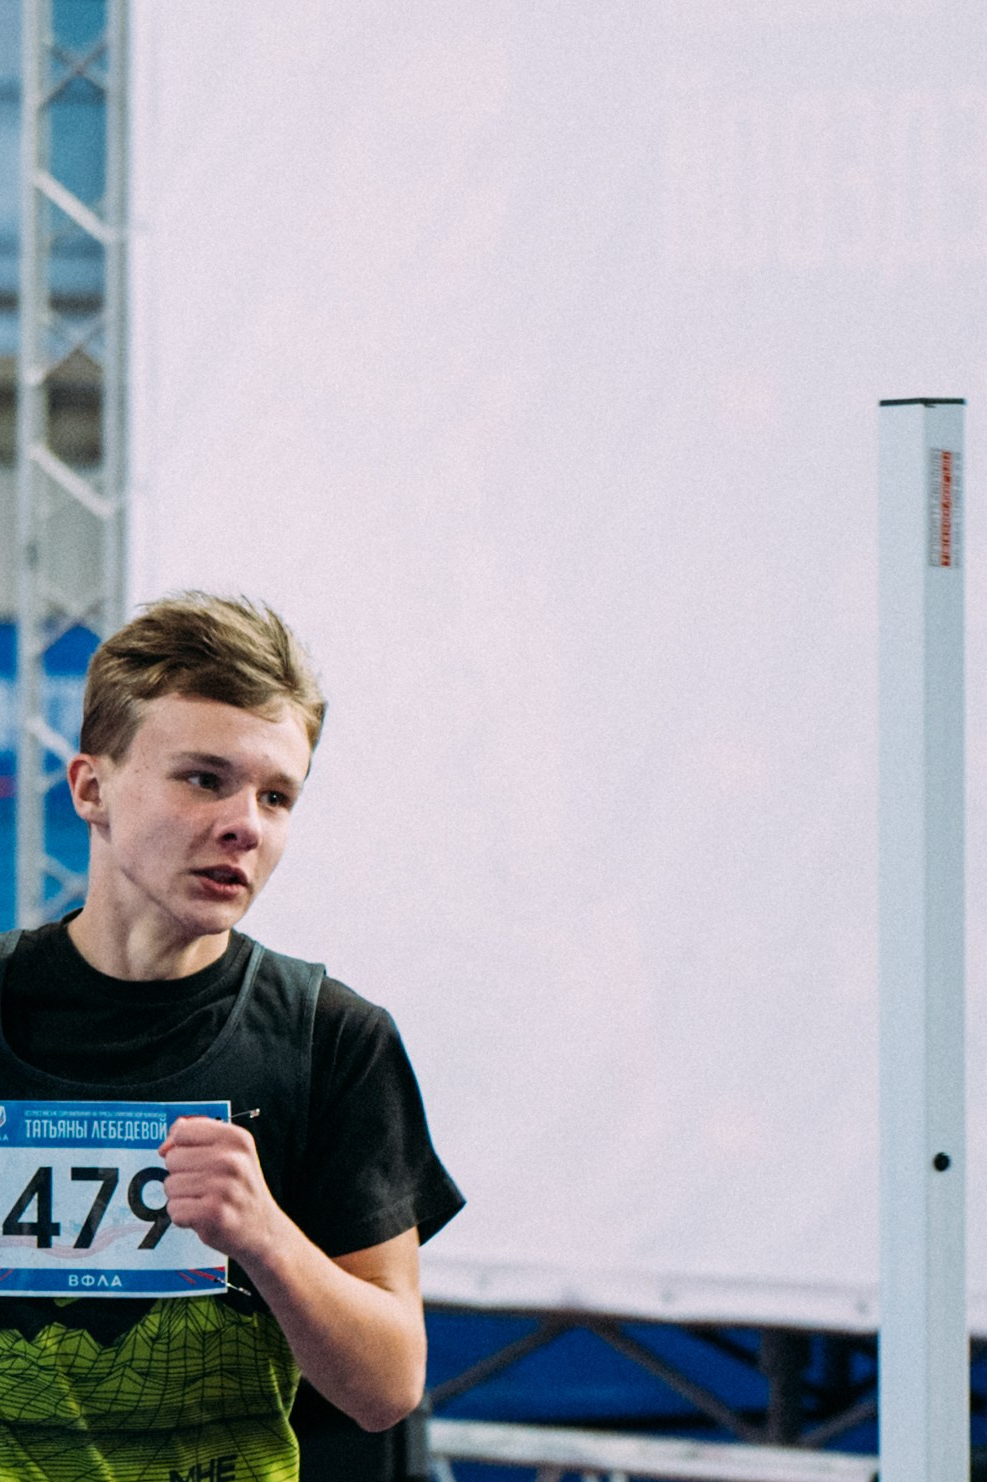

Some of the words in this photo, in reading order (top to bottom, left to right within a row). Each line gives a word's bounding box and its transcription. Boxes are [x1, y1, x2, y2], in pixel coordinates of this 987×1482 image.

[24, 1119, 88, 1138] ТАТЬЯНЫ
[91, 1118, 168, 1141] ЛЕБЕДЕВОЙ
[1, 1166, 172, 1250] 479
[68, 1274, 123, 1287] ВФЛА
